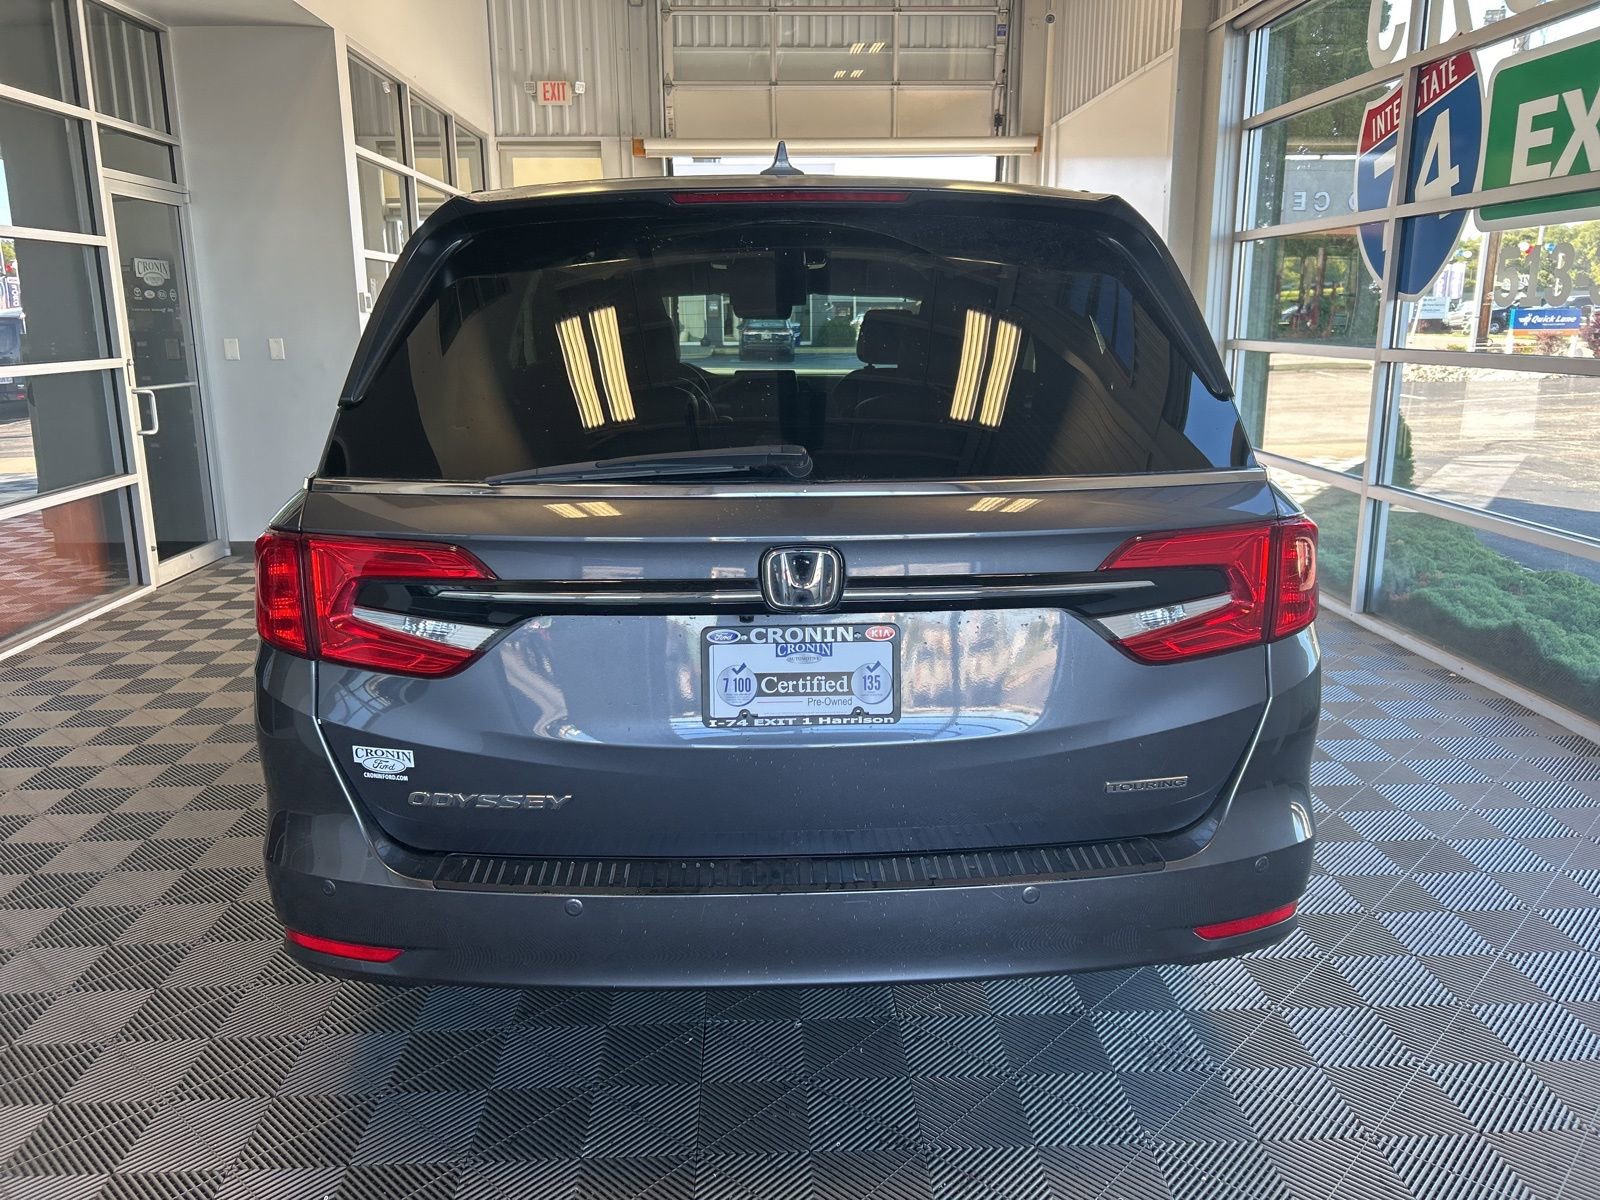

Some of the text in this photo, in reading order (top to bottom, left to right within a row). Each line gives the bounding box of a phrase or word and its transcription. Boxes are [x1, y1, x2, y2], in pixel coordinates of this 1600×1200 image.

[543, 82, 566, 101] EXIT
[1531, 315, 1577, 324] Quick Lane
[713, 632, 734, 641] Ford
[750, 627, 854, 644] CRONIN
[870, 629, 891, 638] KIA
[777, 643, 832, 656] CRONIN
[761, 675, 849, 694] Certified
[862, 674, 881, 691] 135
[807, 697, 853, 706] Pre-Owned
[709, 716, 895, 727] I-74 EXIT 1 Harrison
[354, 746, 414, 764] CRONIN
[372, 758, 397, 771] Ford
[363, 771, 409, 781] CRONINFORD.COM
[1110, 779, 1186, 791] TOURING
[407, 791, 572, 810] ODYSSEY
